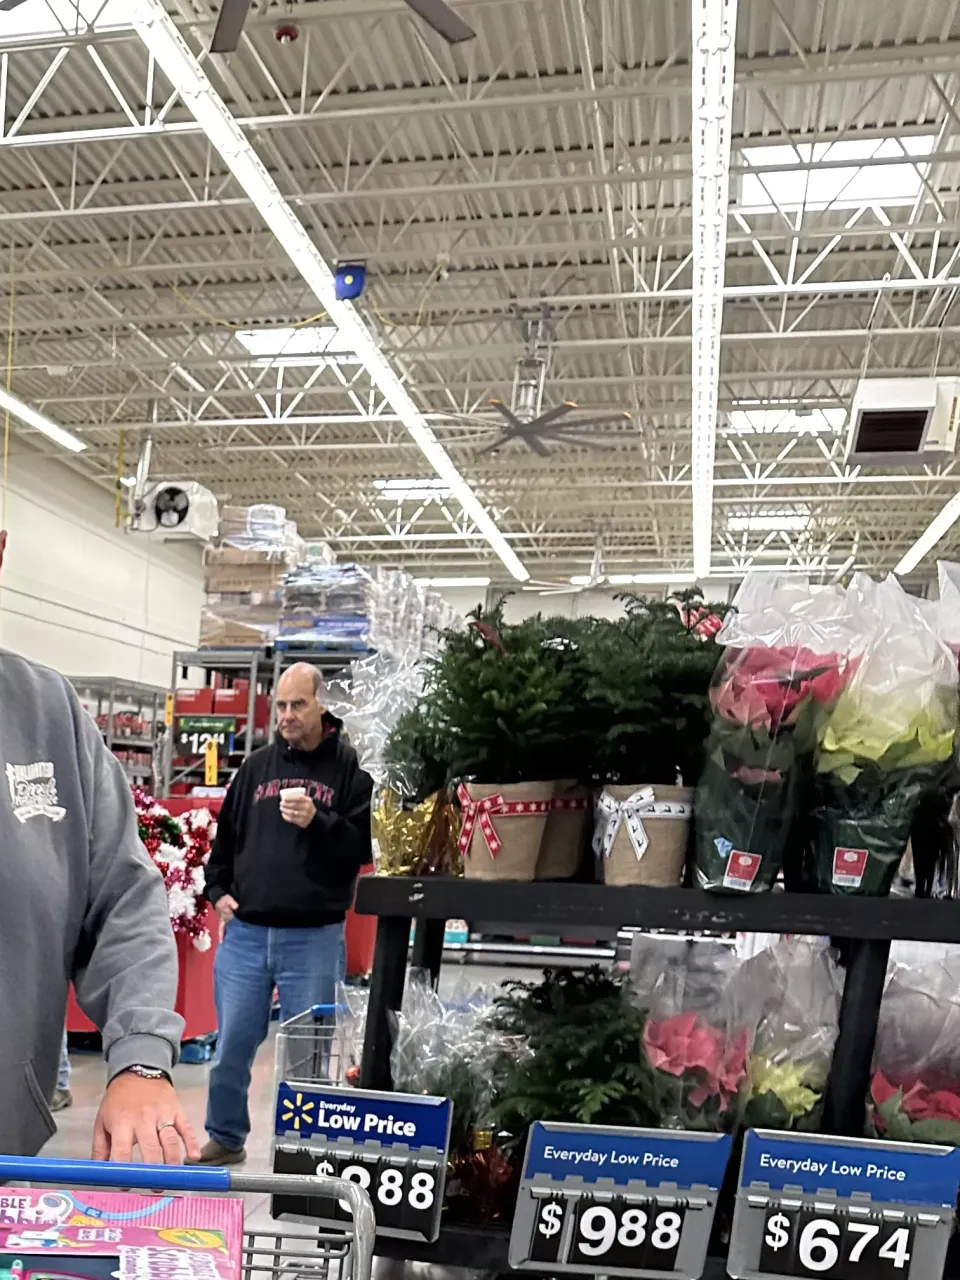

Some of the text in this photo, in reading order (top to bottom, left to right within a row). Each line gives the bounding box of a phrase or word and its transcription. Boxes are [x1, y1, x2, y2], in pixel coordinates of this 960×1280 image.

[320, 1101, 356, 1114] Everyday
[318, 1109, 417, 1137] Low Price
[543, 1145, 679, 1168] Everyday Low Price
[759, 1153, 907, 1182] Everyday Low Price
